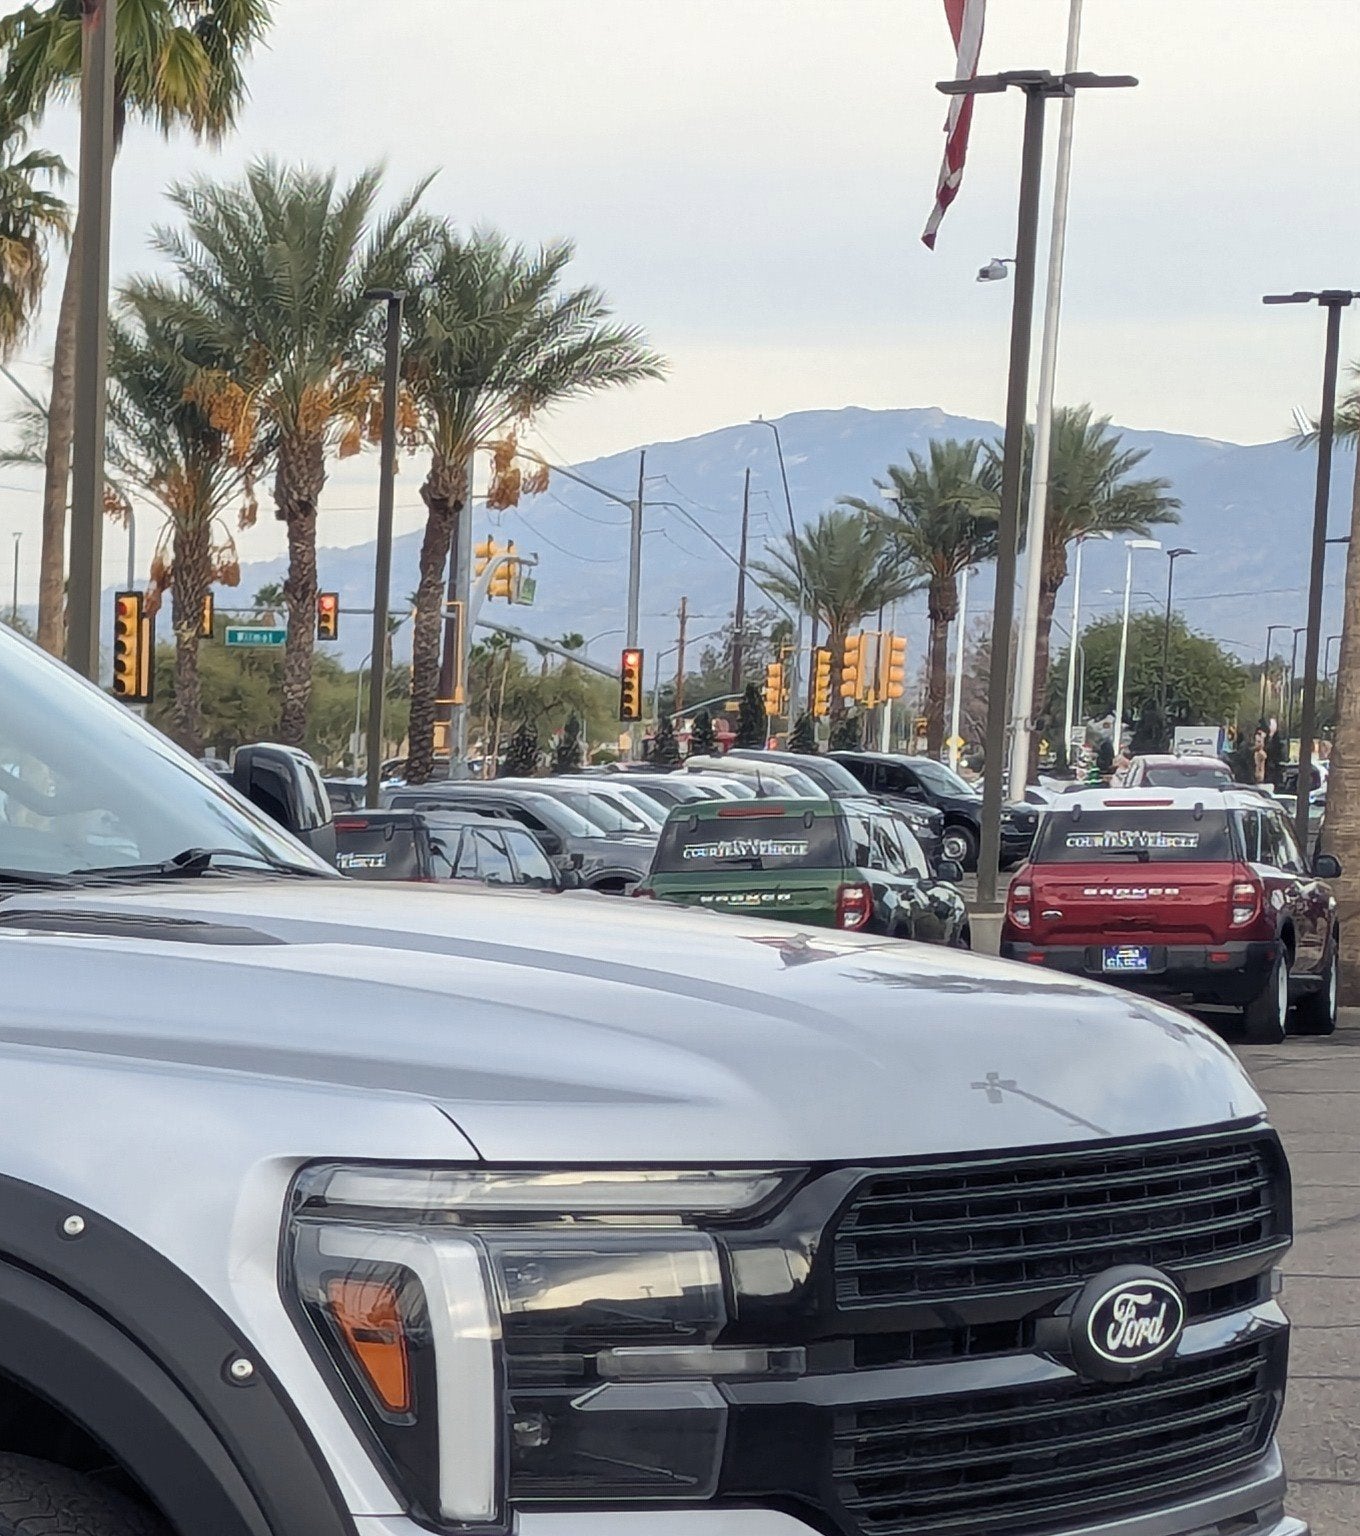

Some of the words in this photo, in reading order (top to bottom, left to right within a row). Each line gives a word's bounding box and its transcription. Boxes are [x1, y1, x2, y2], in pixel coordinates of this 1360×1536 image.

[683, 842, 749, 859] COURTESY
[750, 842, 809, 856] VEHICLE
[1066, 837, 1136, 848] COURTESY
[1139, 836, 1198, 848] VEHICLE
[1106, 1292, 1167, 1351] Ford
